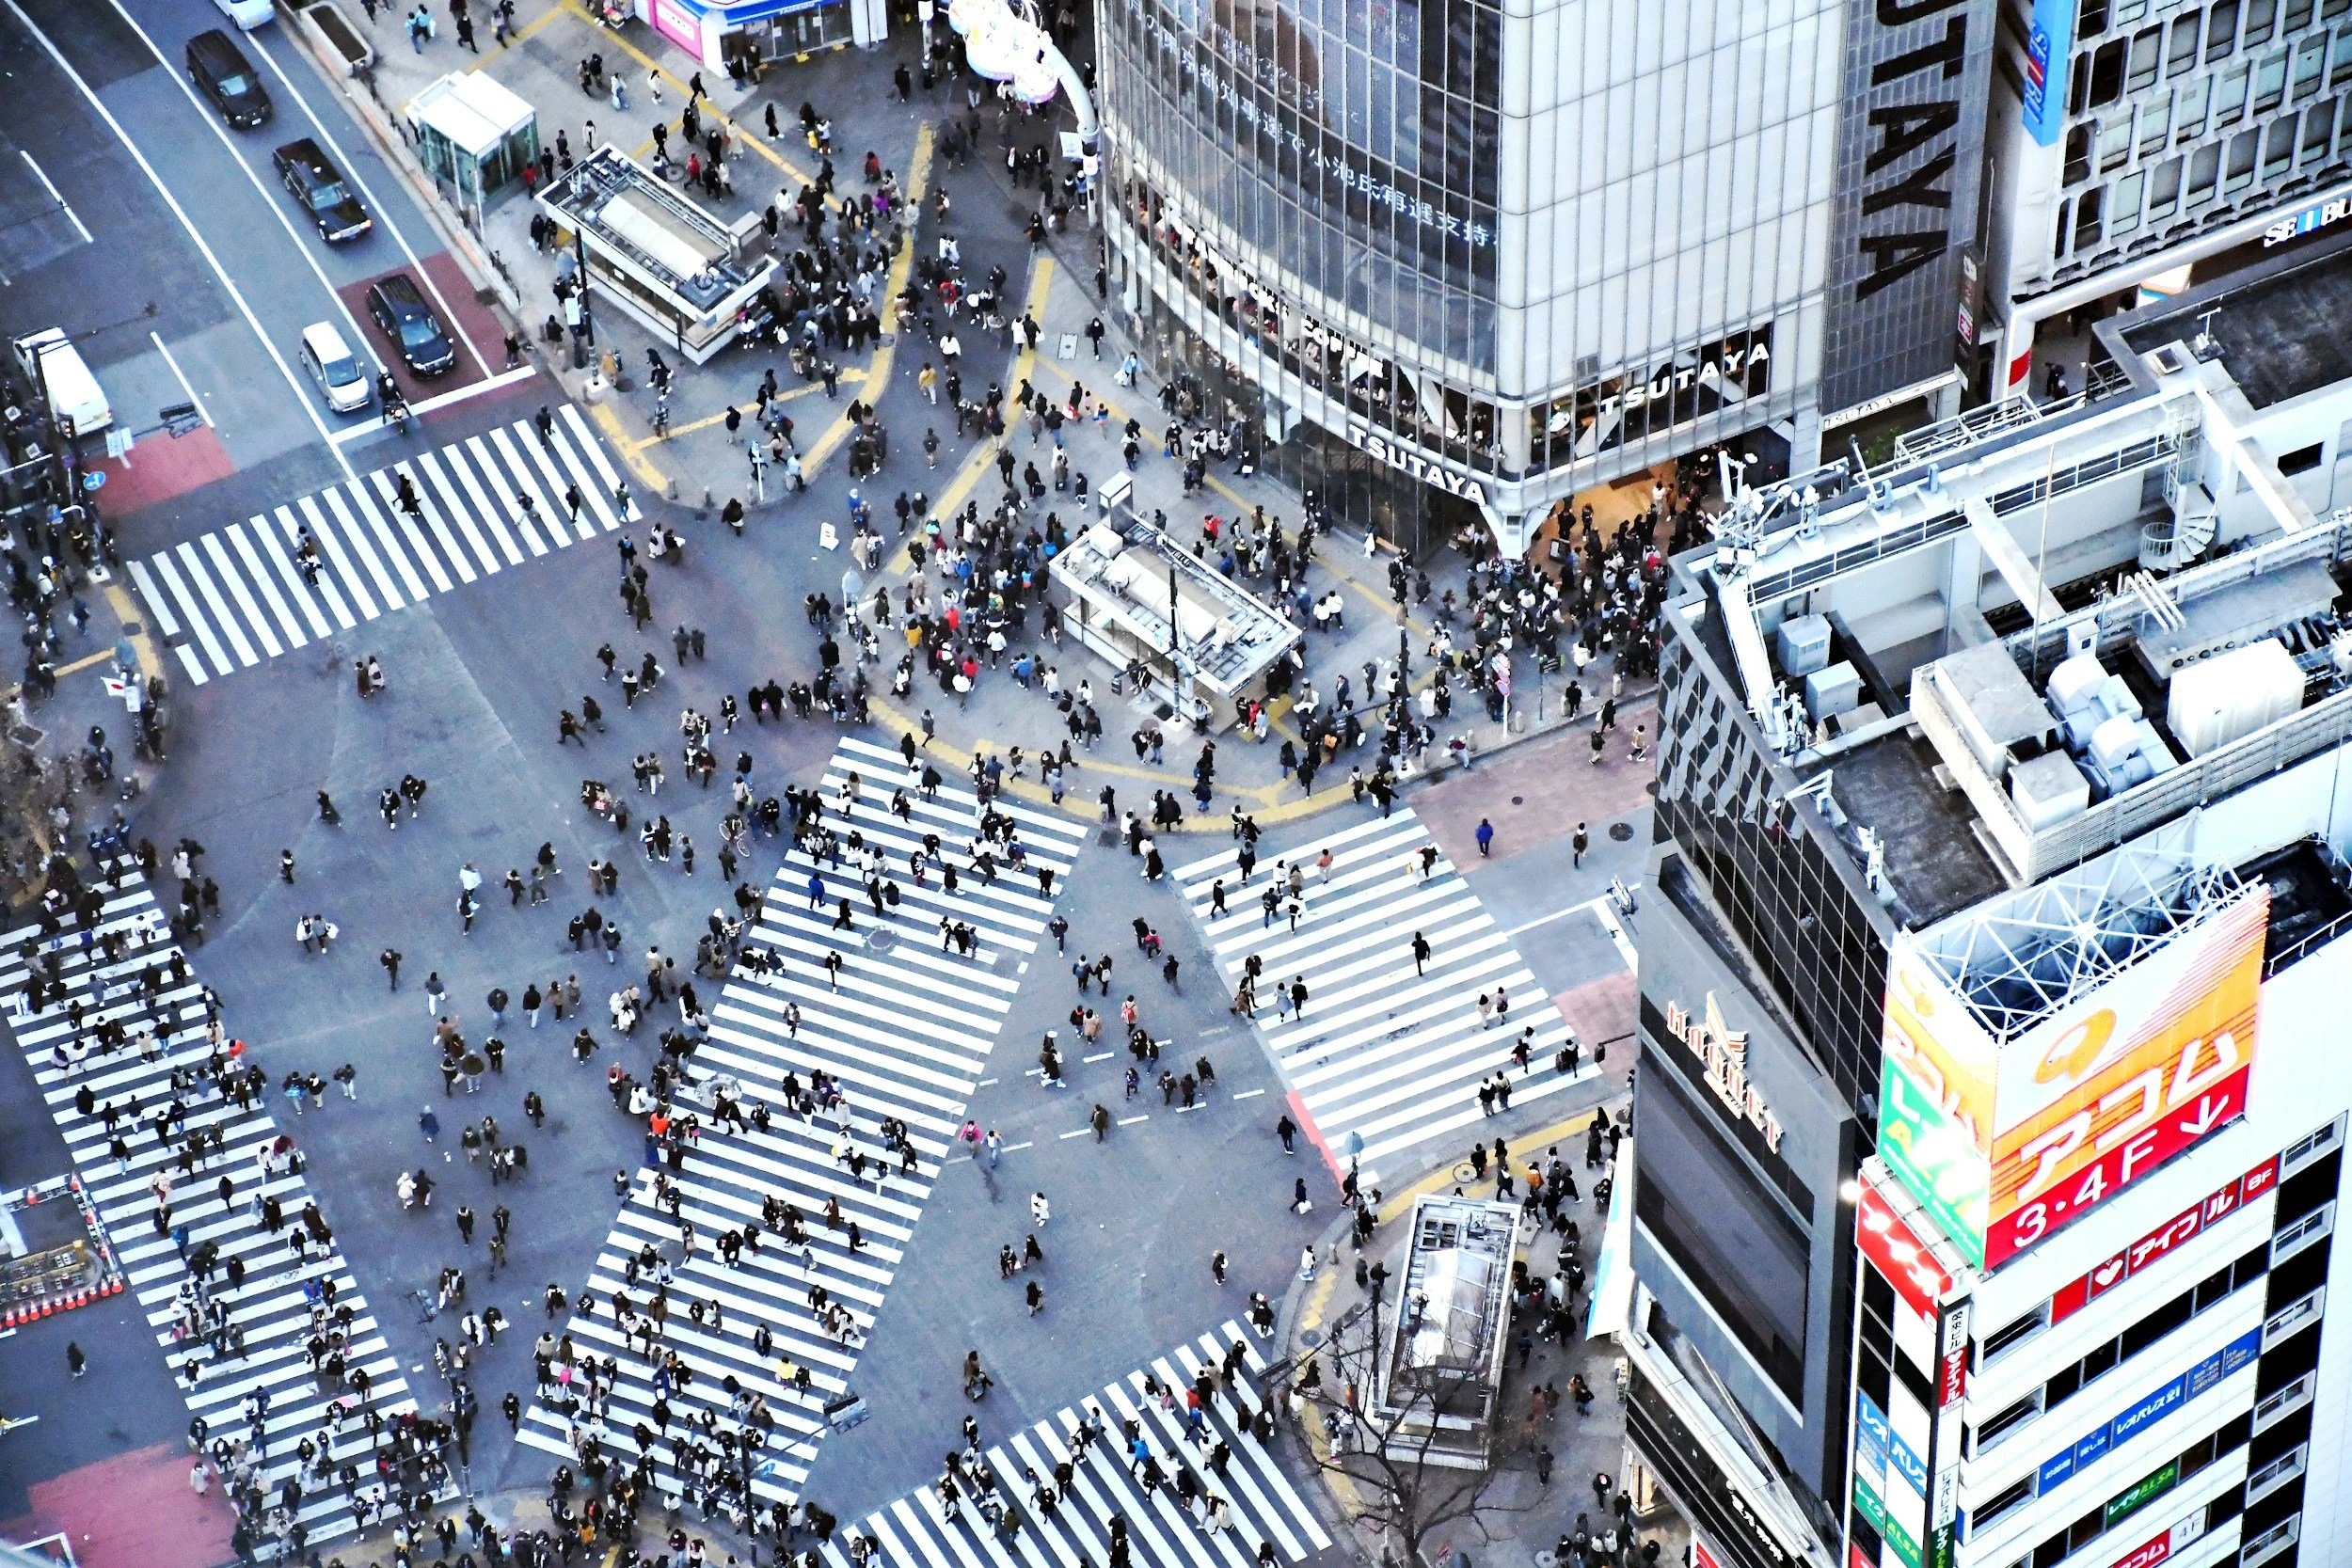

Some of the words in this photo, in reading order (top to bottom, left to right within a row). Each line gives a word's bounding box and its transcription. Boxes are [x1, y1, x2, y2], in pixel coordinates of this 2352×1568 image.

[1599, 342, 1769, 417] TSUTAYA
[1824, 397, 1893, 430] TSUTAYA
[1349, 424, 1486, 507] TSUTAYA
[2016, 1032, 2238, 1202] アコム
[2132, 1195, 2234, 1269] アイフル
[2248, 1167, 2273, 1191] 8F
[1946, 1360, 1962, 1404] アイフル
[2117, 1385, 2181, 1435] レオパレス21
[1855, 1480, 1884, 1517] レイク
[1886, 1522, 1919, 1562] ALSA
[2108, 1489, 2140, 1516] レイク
[2138, 1467, 2175, 1497] ALSA
